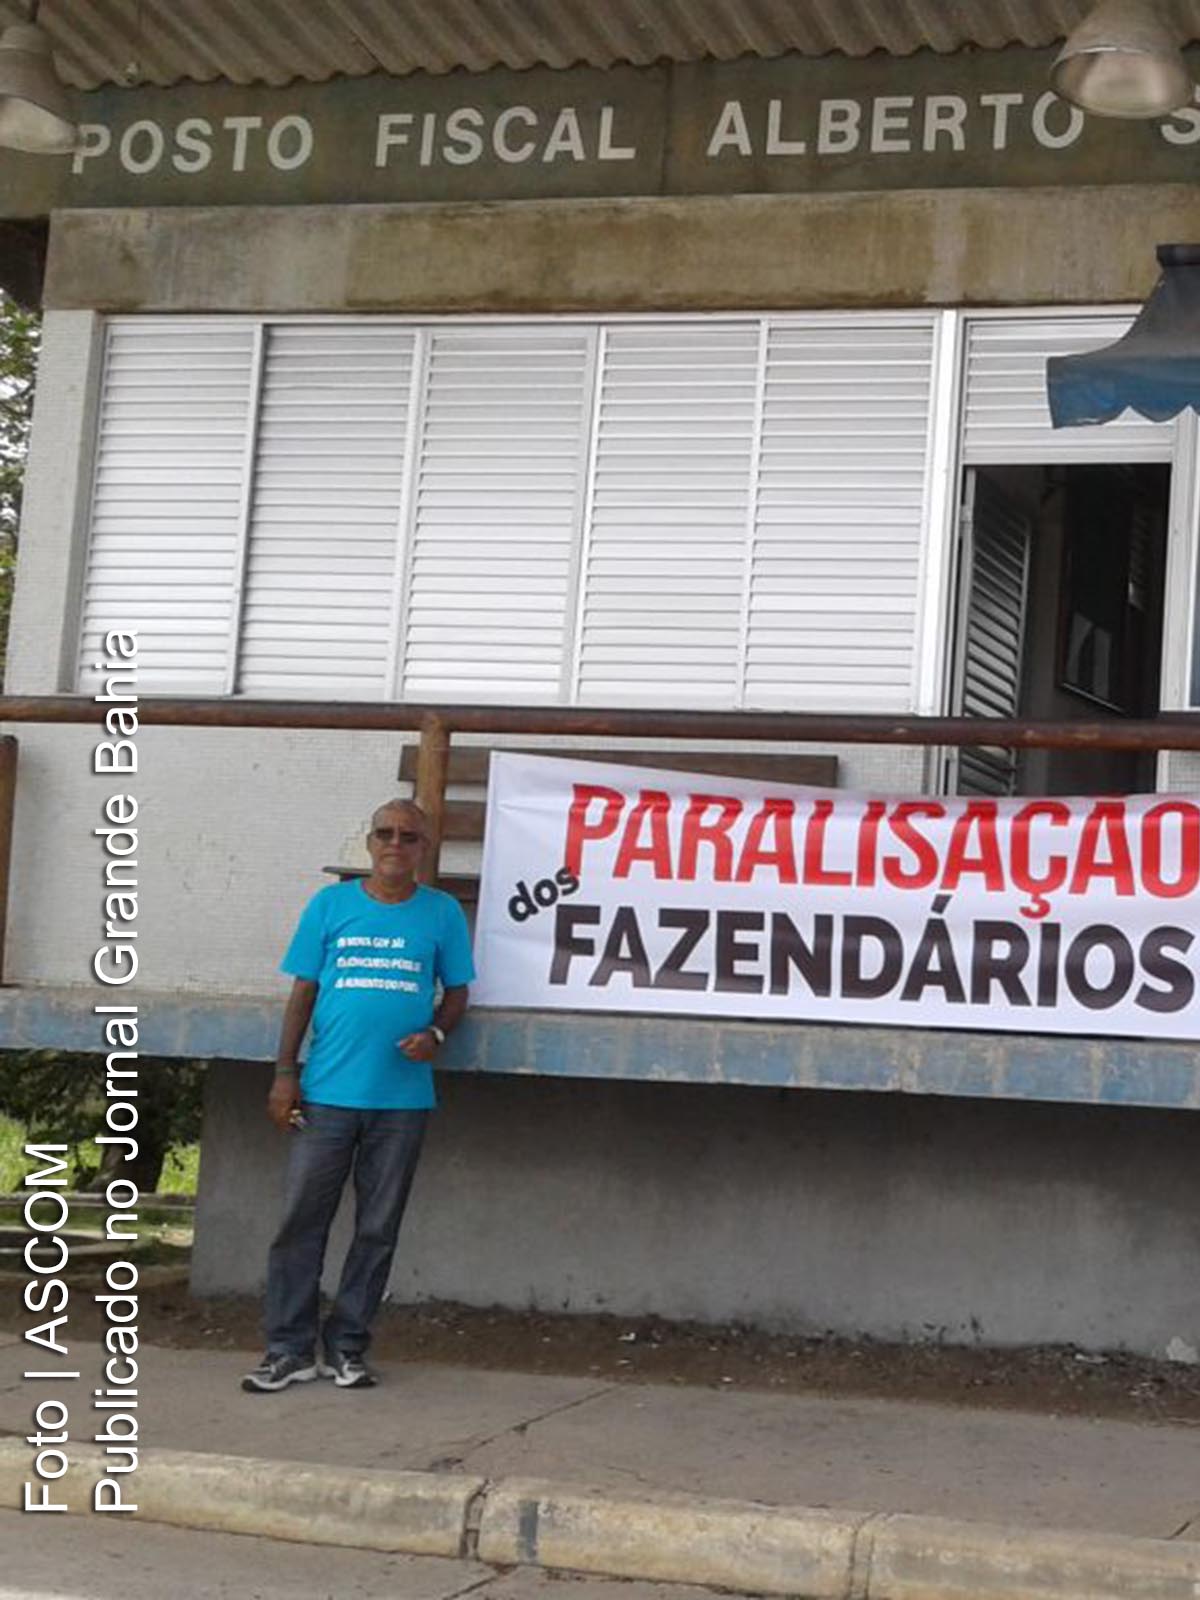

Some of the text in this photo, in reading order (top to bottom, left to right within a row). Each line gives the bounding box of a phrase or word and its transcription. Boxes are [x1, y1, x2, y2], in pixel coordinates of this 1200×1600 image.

[73, 115, 313, 174] POSTO
[375, 106, 636, 167] FISCAL
[706, 92, 1084, 157] ALBERTO
[508, 867, 579, 922] dos
[549, 894, 1196, 1013] FAZENDÁRIOS
